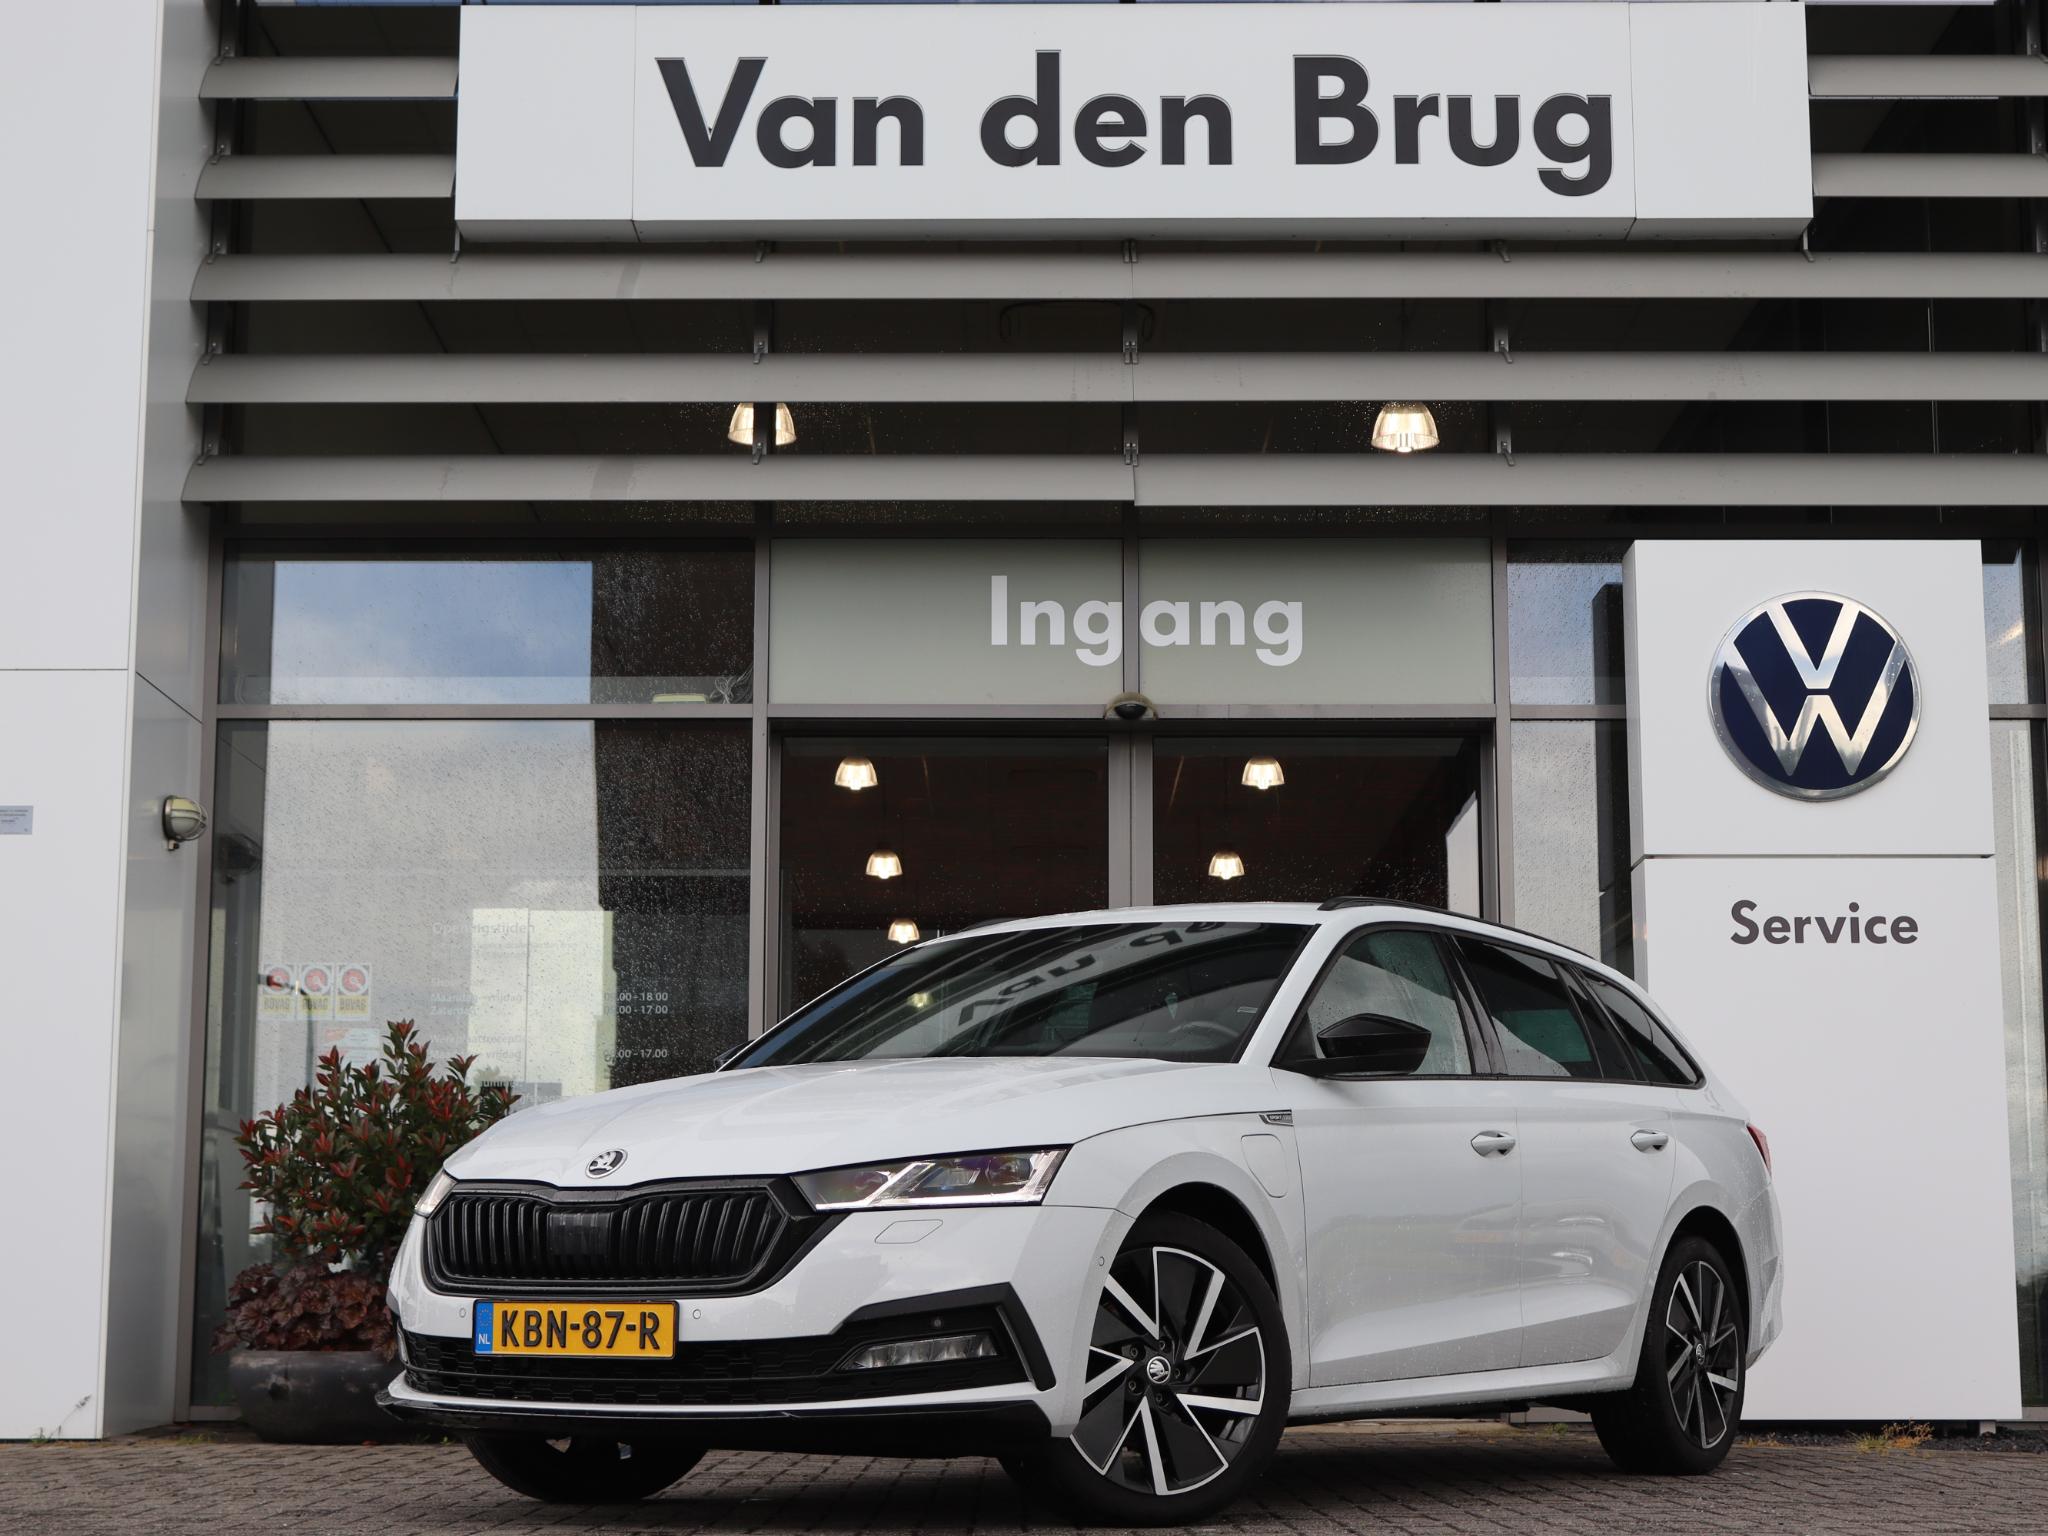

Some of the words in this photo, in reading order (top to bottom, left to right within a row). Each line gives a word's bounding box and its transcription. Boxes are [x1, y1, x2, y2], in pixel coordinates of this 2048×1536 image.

[655, 56, 925, 168] Van
[980, 49, 1233, 168] den
[1292, 54, 1613, 197] Brug
[991, 575, 1303, 667] Ingang
[1730, 899, 1919, 945] Service
[640, 1049, 668, 1058] 17.00
[478, 1333, 491, 1345] NL
[501, 1309, 660, 1350] KBN-87-R
